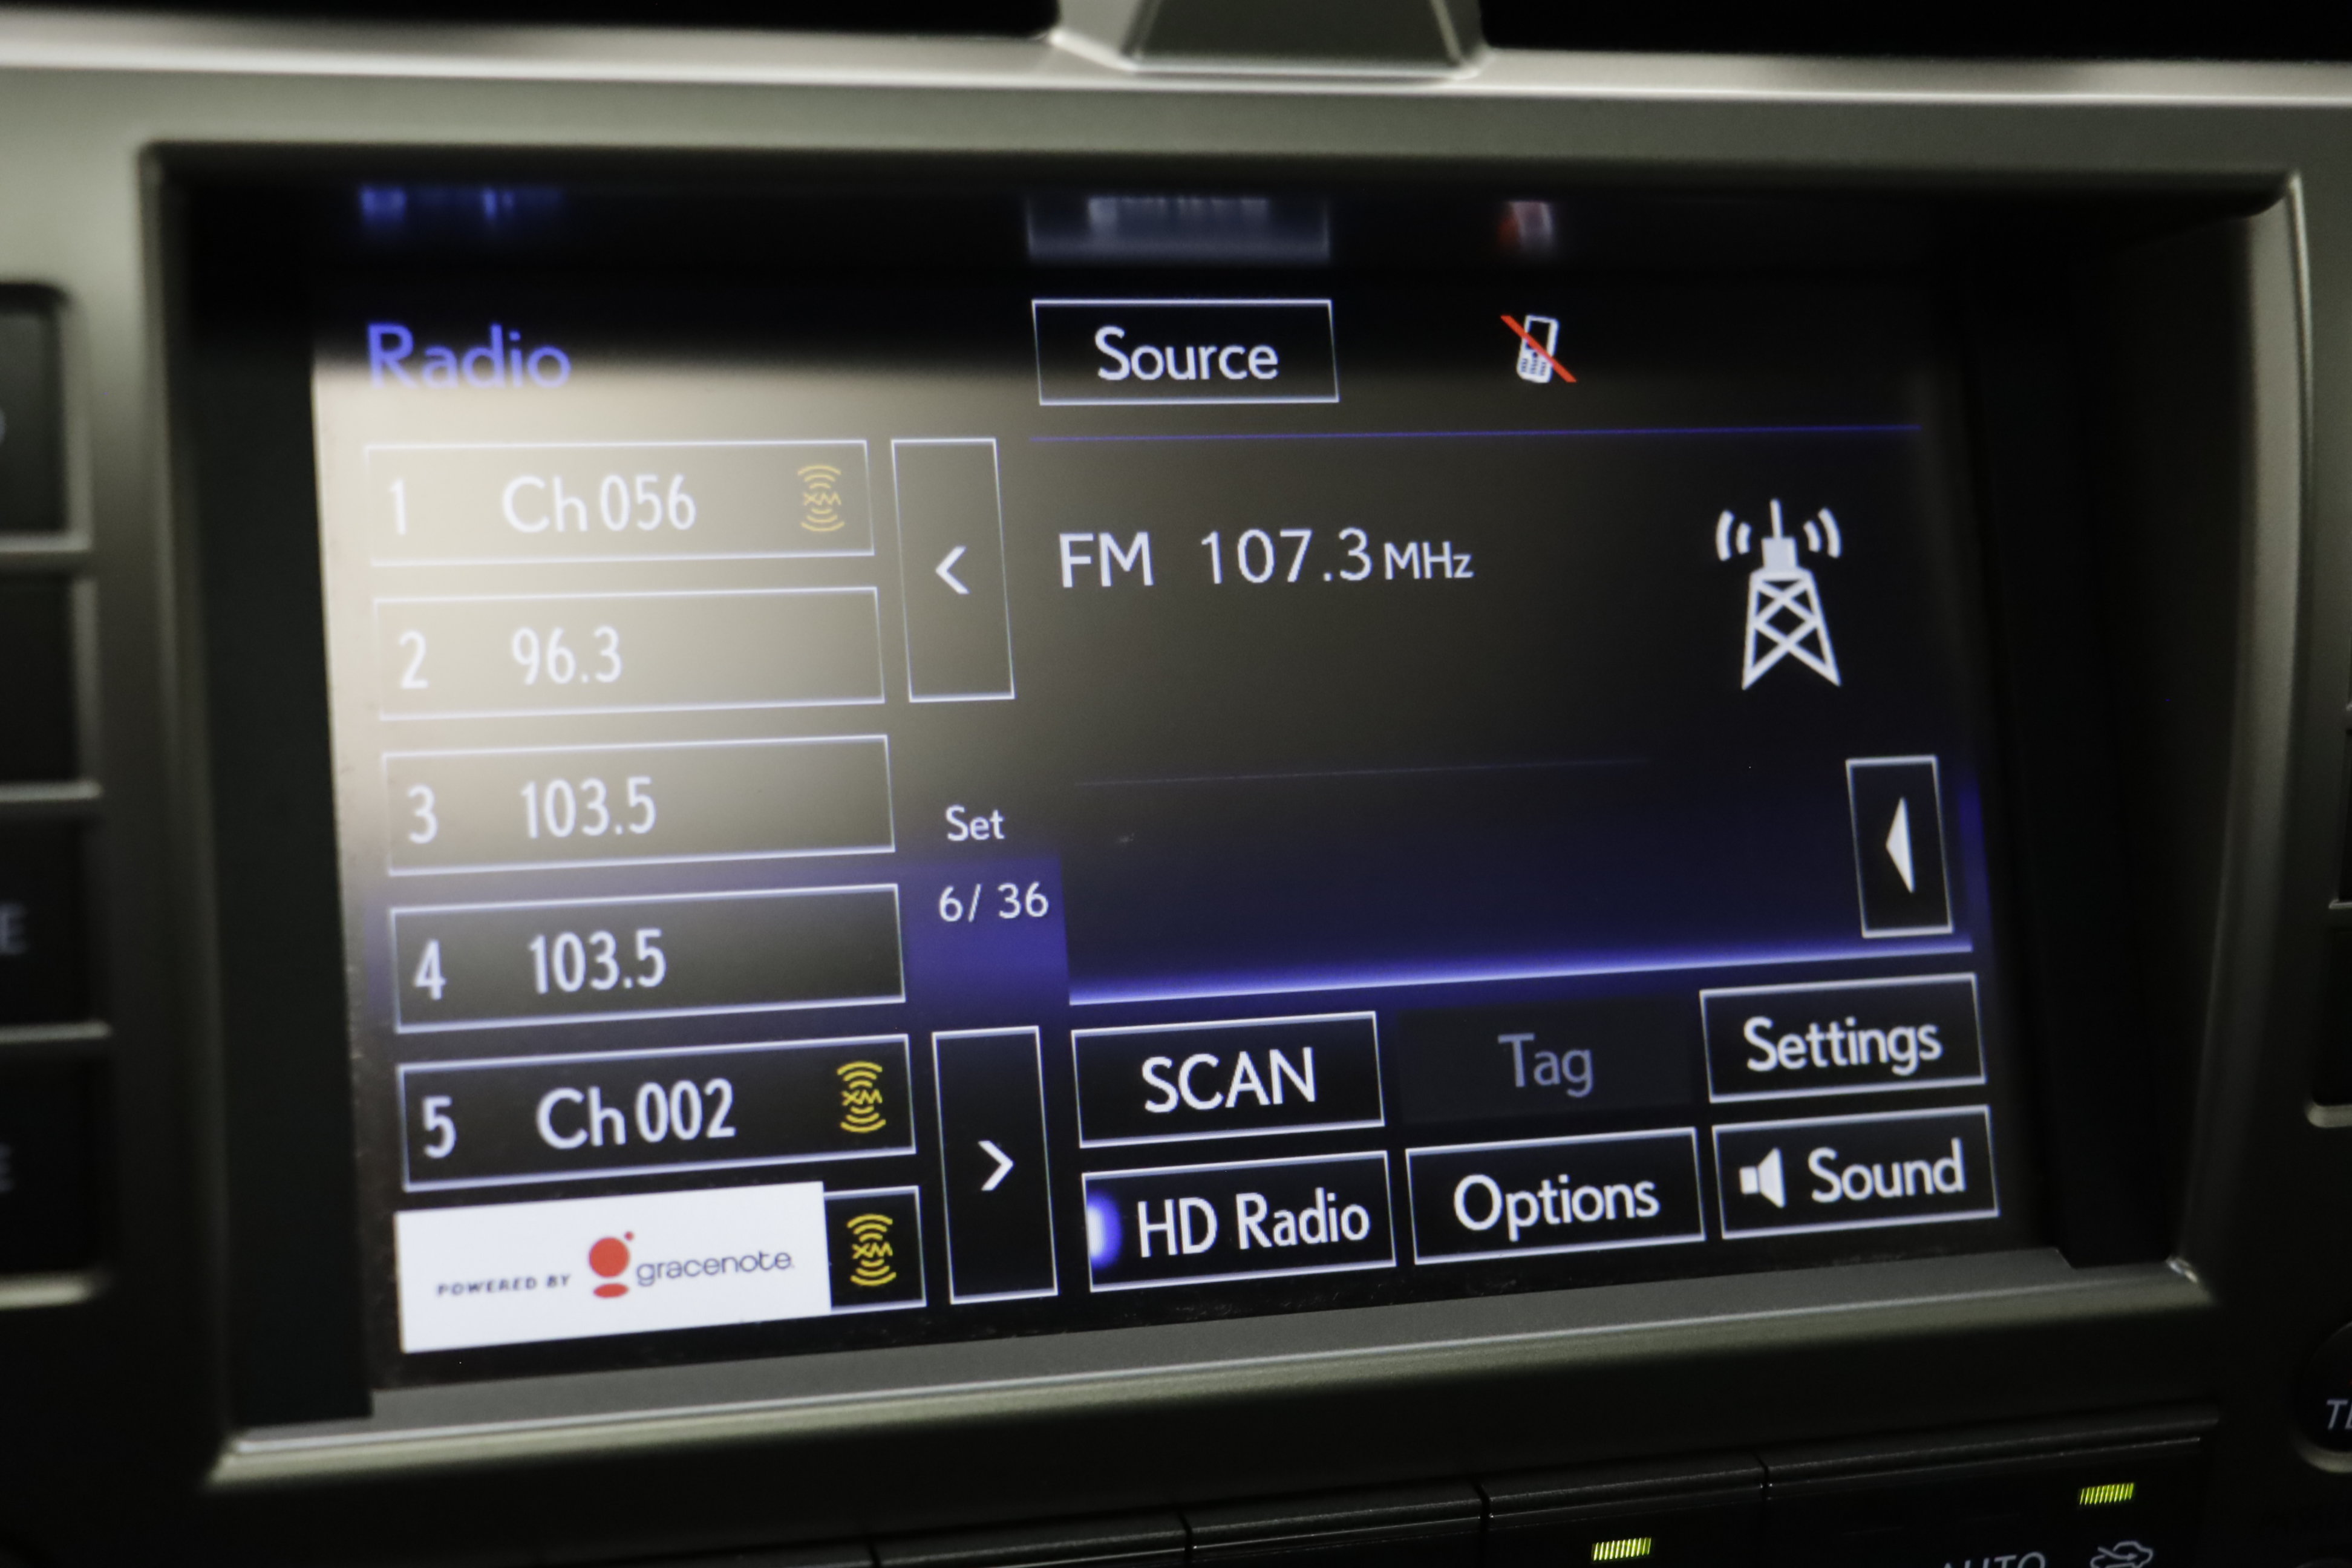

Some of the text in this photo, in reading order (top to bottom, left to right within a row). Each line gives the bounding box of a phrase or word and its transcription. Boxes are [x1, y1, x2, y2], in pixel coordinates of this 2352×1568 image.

[367, 321, 572, 389] Radio
[1094, 325, 1278, 381] Source
[389, 478, 407, 535] 1
[501, 474, 697, 533] Ch 056
[1059, 531, 1154, 588] FM
[399, 629, 429, 690] 2
[511, 625, 622, 685] 96.3
[408, 785, 438, 844] 3
[521, 776, 656, 838] 103.5
[945, 805, 1005, 841] Set
[414, 939, 446, 1001] 4
[529, 928, 667, 994] 103.5
[1497, 1033, 1593, 1098] Tag
[1743, 1016, 1943, 1076] Settings
[1142, 1047, 1316, 1113] SCAN
[423, 1096, 456, 1158] 5
[537, 1077, 736, 1149] Ch 002
[1808, 1137, 1966, 1203] Sound
[1137, 1187, 1370, 1258] HD Radio
[1454, 1174, 1661, 1242] Options
[437, 1275, 570, 1296] POWERED BY
